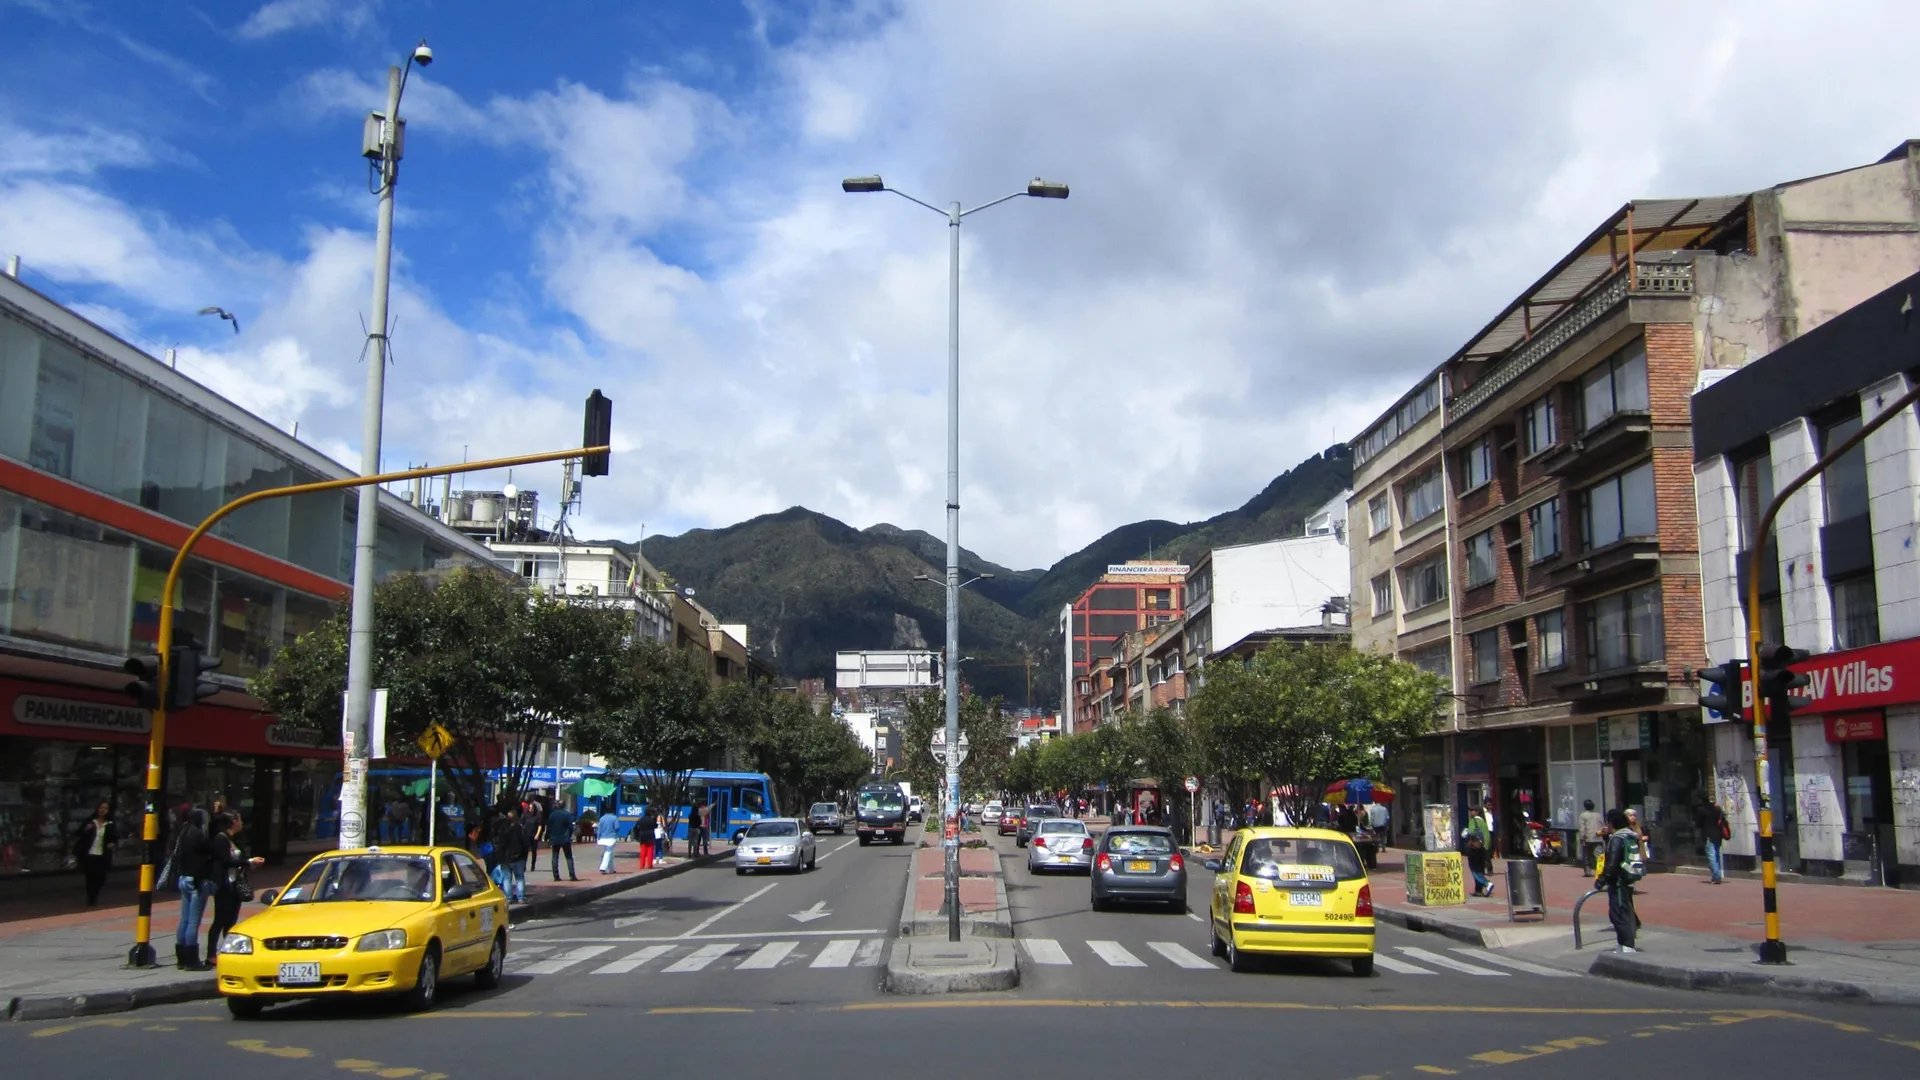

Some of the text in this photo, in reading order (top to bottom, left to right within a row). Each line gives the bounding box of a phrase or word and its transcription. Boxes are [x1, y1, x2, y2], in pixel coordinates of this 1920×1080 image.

[1832, 660, 1893, 697] Villas
[25, 700, 144, 728] PANAMERICANA
[280, 966, 318, 977] SIL-241
